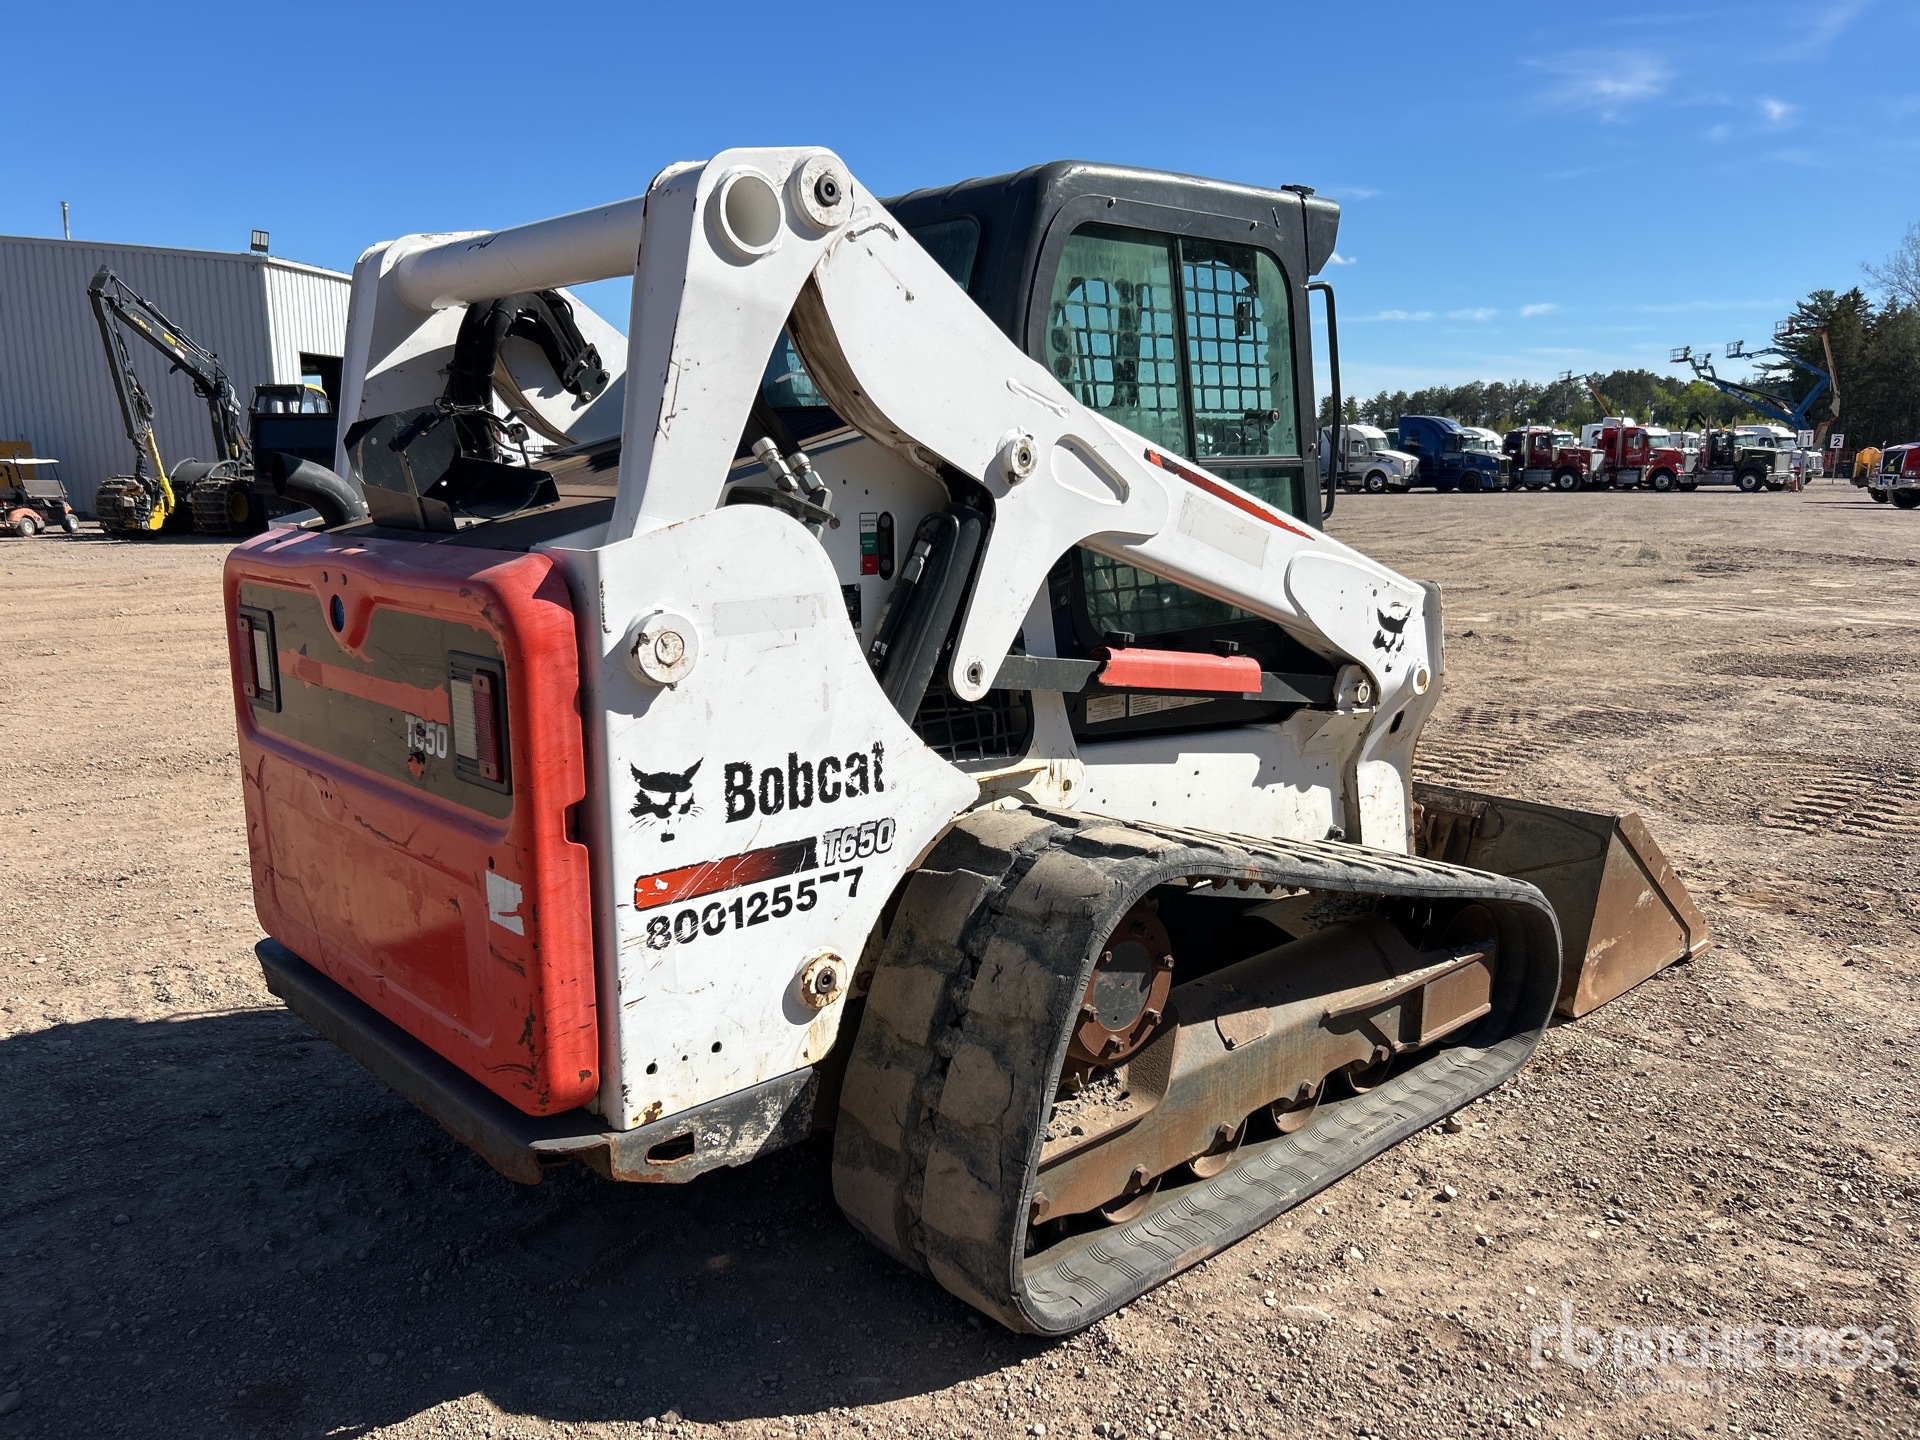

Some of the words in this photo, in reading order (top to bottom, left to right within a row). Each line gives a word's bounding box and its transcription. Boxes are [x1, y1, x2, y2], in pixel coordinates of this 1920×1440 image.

[1833, 437, 1841, 447] 2
[724, 740, 885, 824] Bobcat
[823, 817, 896, 867] T650
